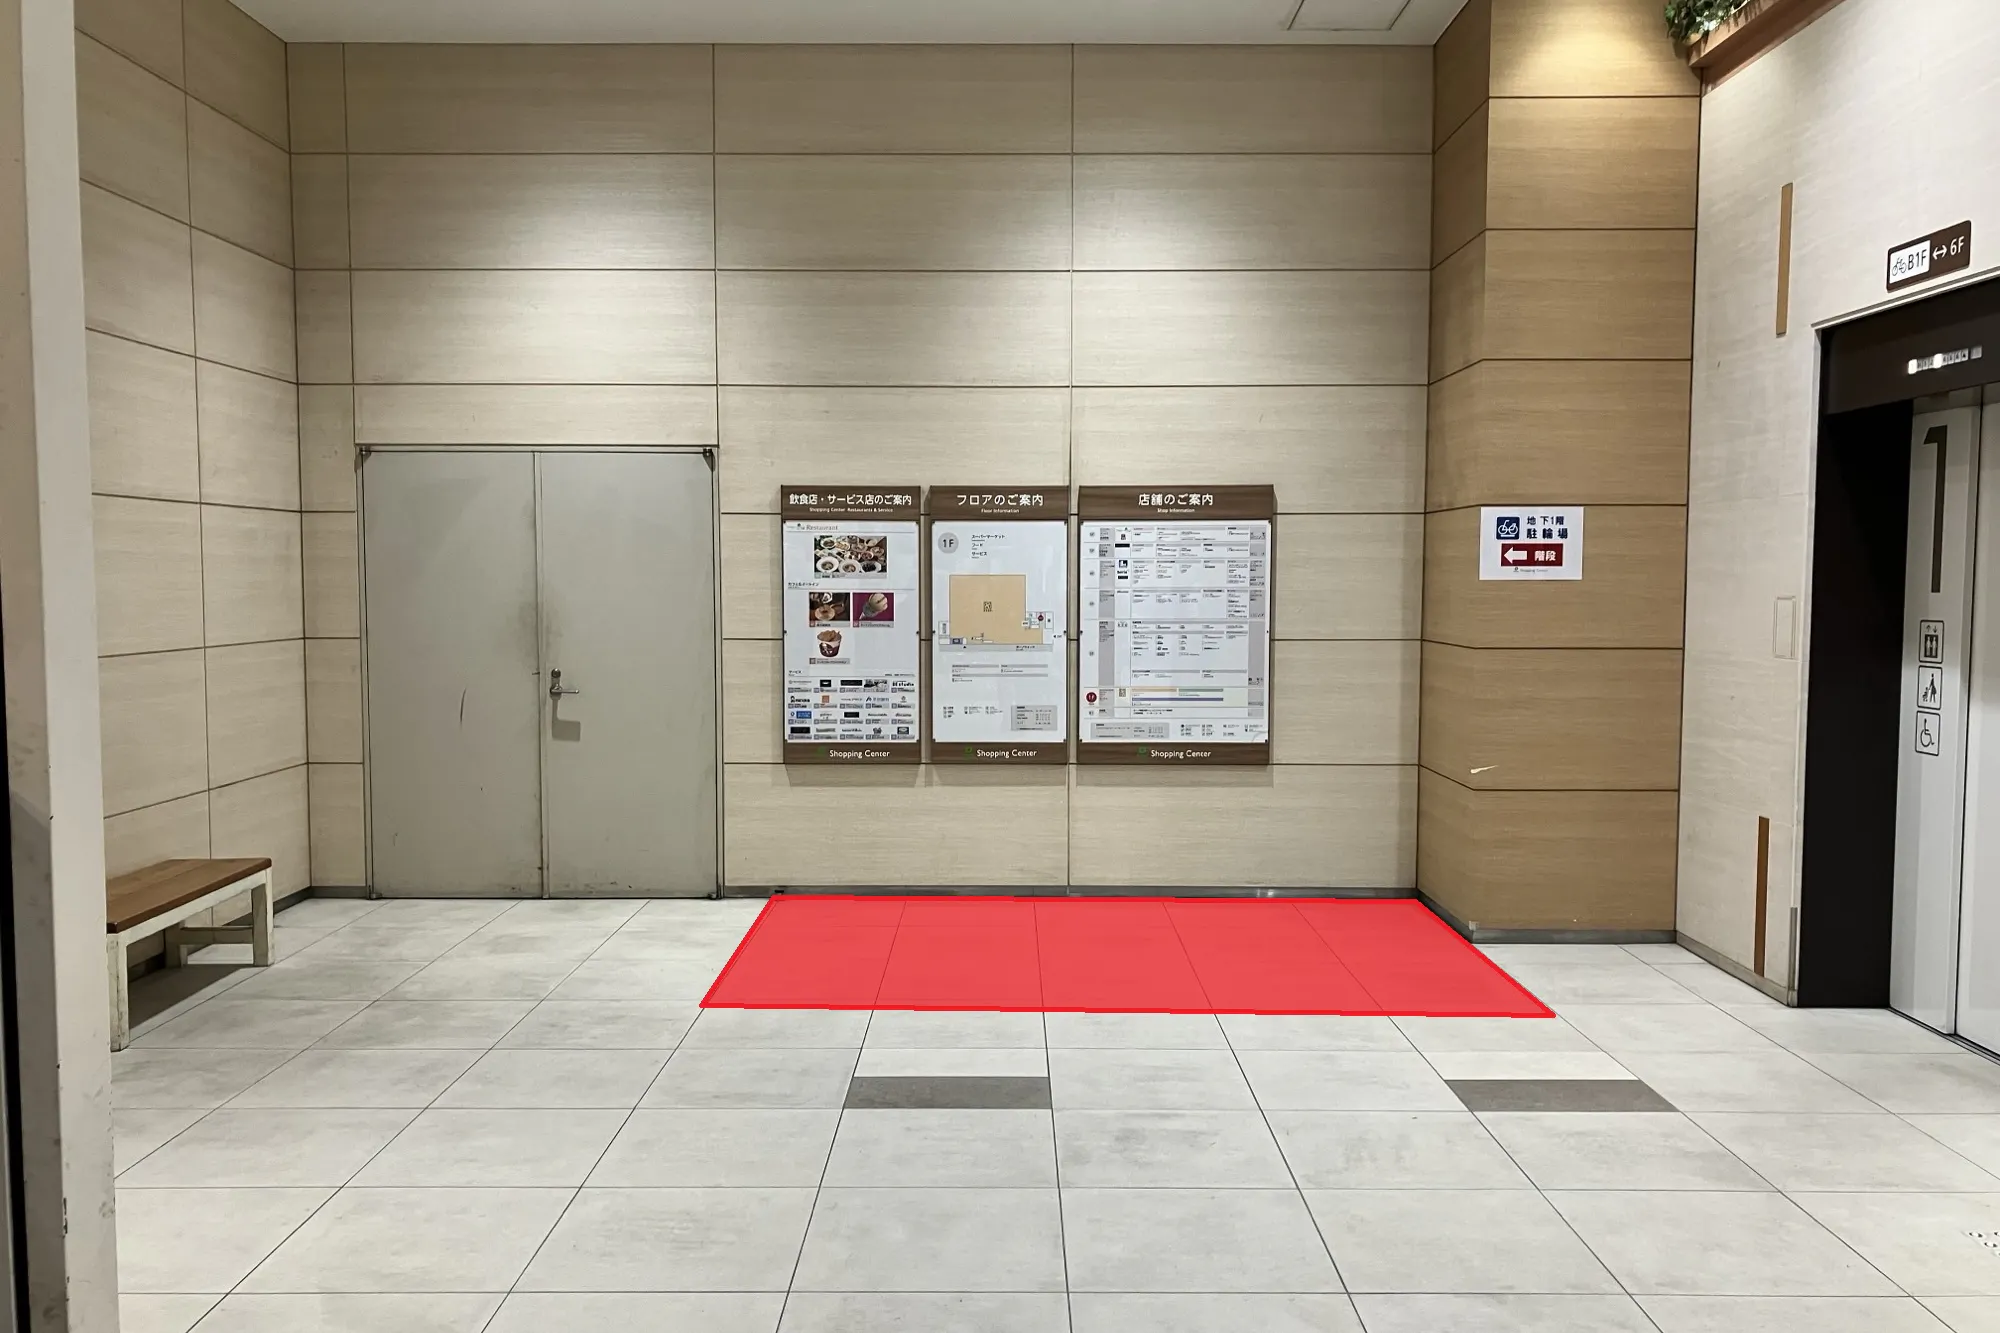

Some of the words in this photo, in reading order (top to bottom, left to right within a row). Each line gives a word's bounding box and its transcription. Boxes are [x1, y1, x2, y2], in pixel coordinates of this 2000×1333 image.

[1949, 236, 1964, 256] 6F
[1908, 249, 1927, 270] B1F
[789, 493, 912, 506] 飲食店・サービス店のご案内
[956, 494, 1044, 506] フロアのご案内
[1138, 493, 1214, 506] 店舗のご案内
[1923, 425, 1947, 593] 1
[1526, 515, 1565, 526] 地下1階
[1526, 528, 1568, 539] 駐輪場
[942, 538, 955, 548] 1F
[1534, 550, 1557, 562] 階段
[829, 750, 863, 759] Shopping
[976, 749, 1010, 758] Shopping
[1011, 749, 1037, 757] Center
[1151, 749, 1184, 758] Shopping
[1185, 749, 1212, 757] Center
